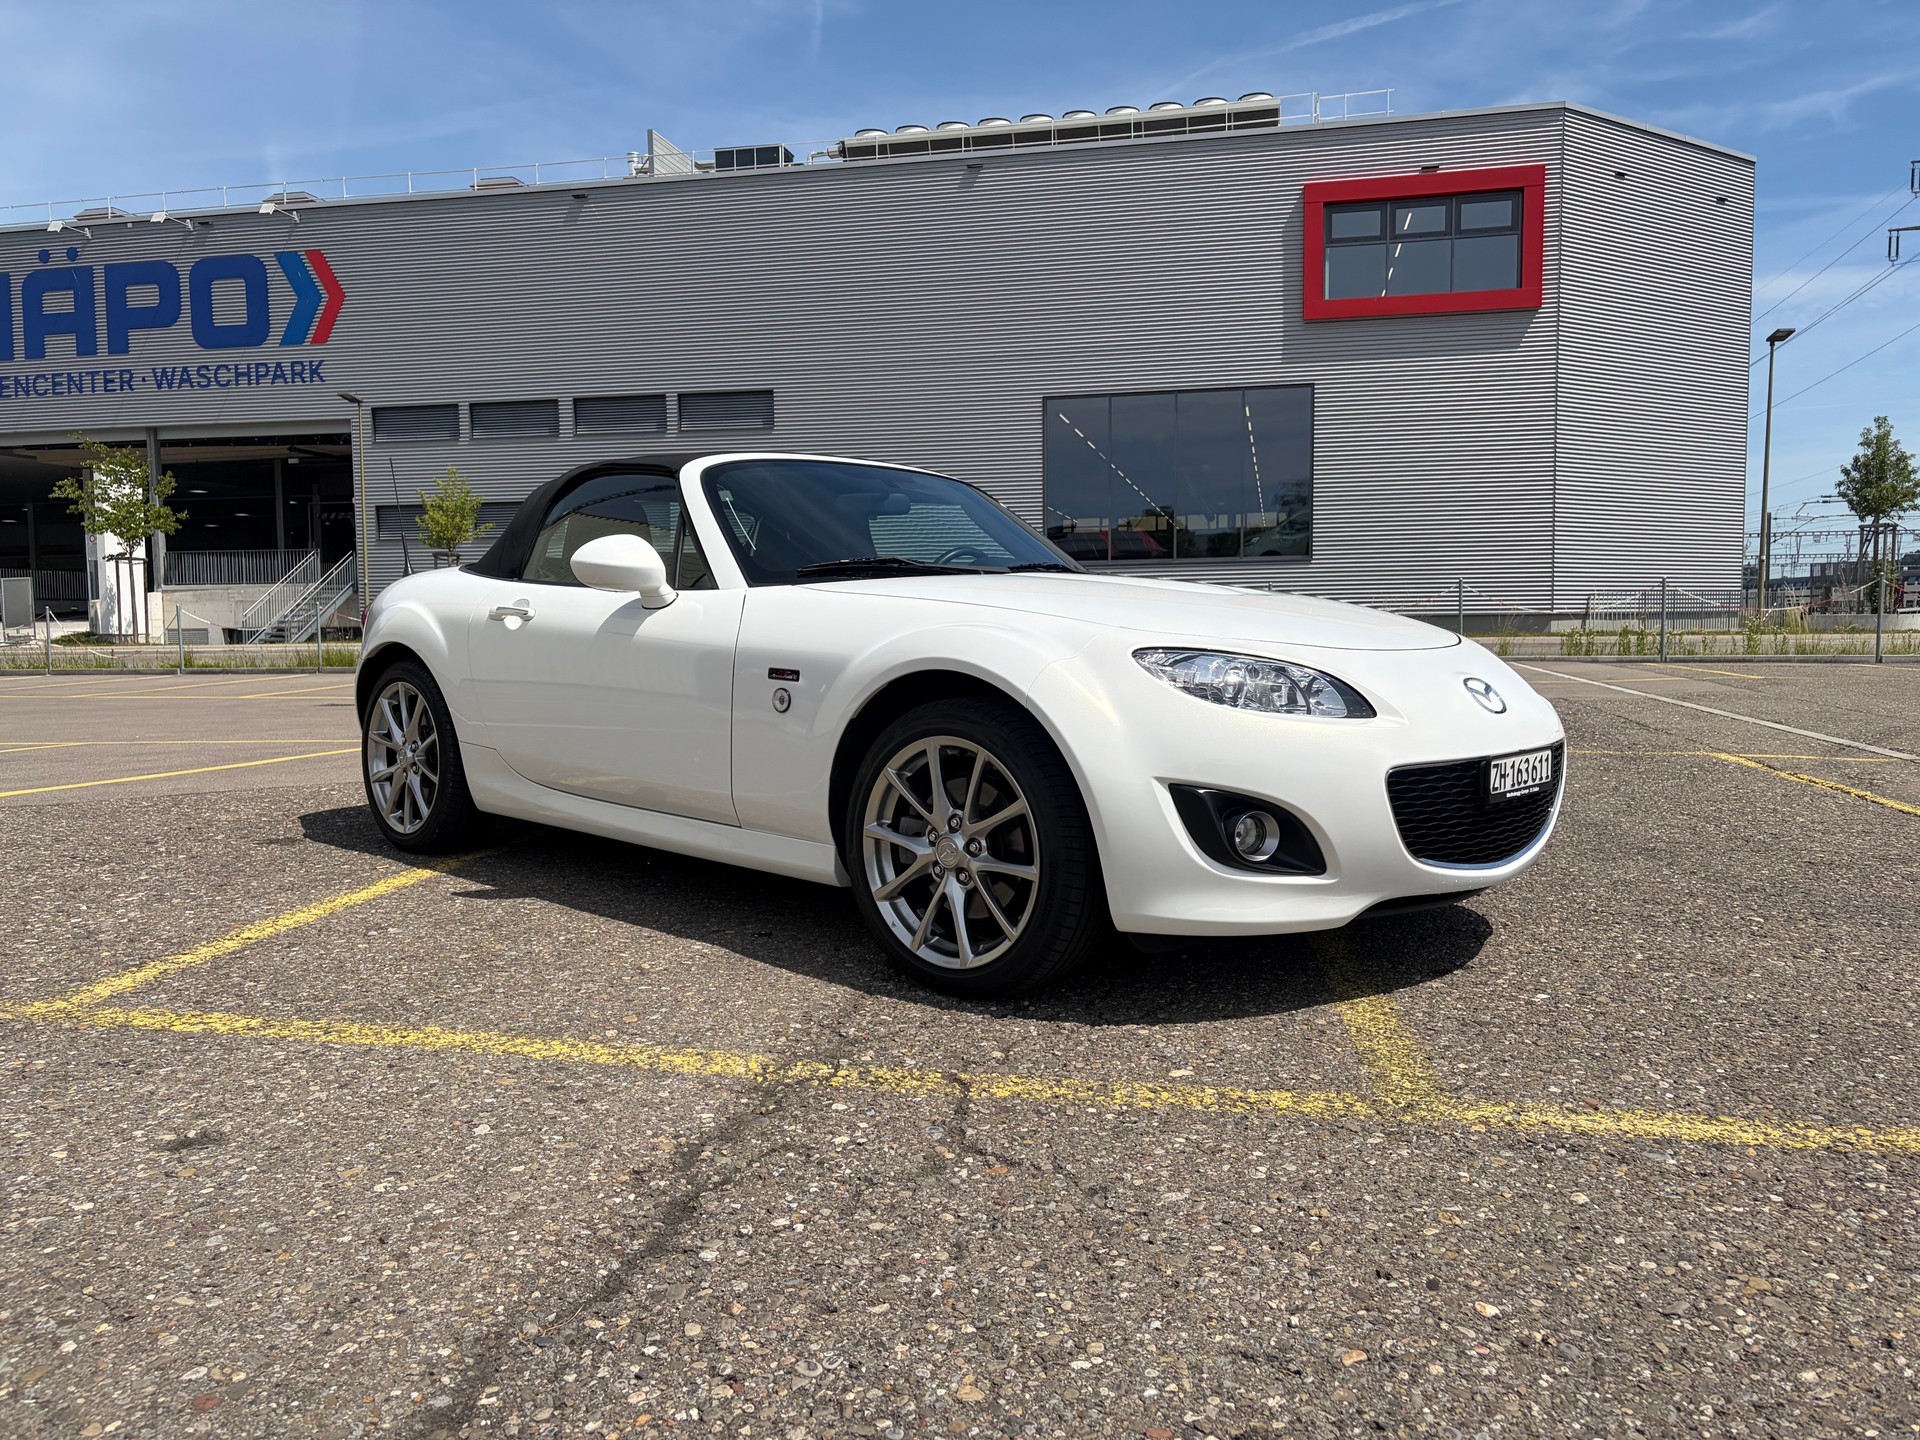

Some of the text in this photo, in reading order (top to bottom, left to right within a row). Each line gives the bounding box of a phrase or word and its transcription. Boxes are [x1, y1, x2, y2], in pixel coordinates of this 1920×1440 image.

[0, 247, 270, 361] ÄPO
[0, 360, 326, 398] ENCENTER WASCHPARK
